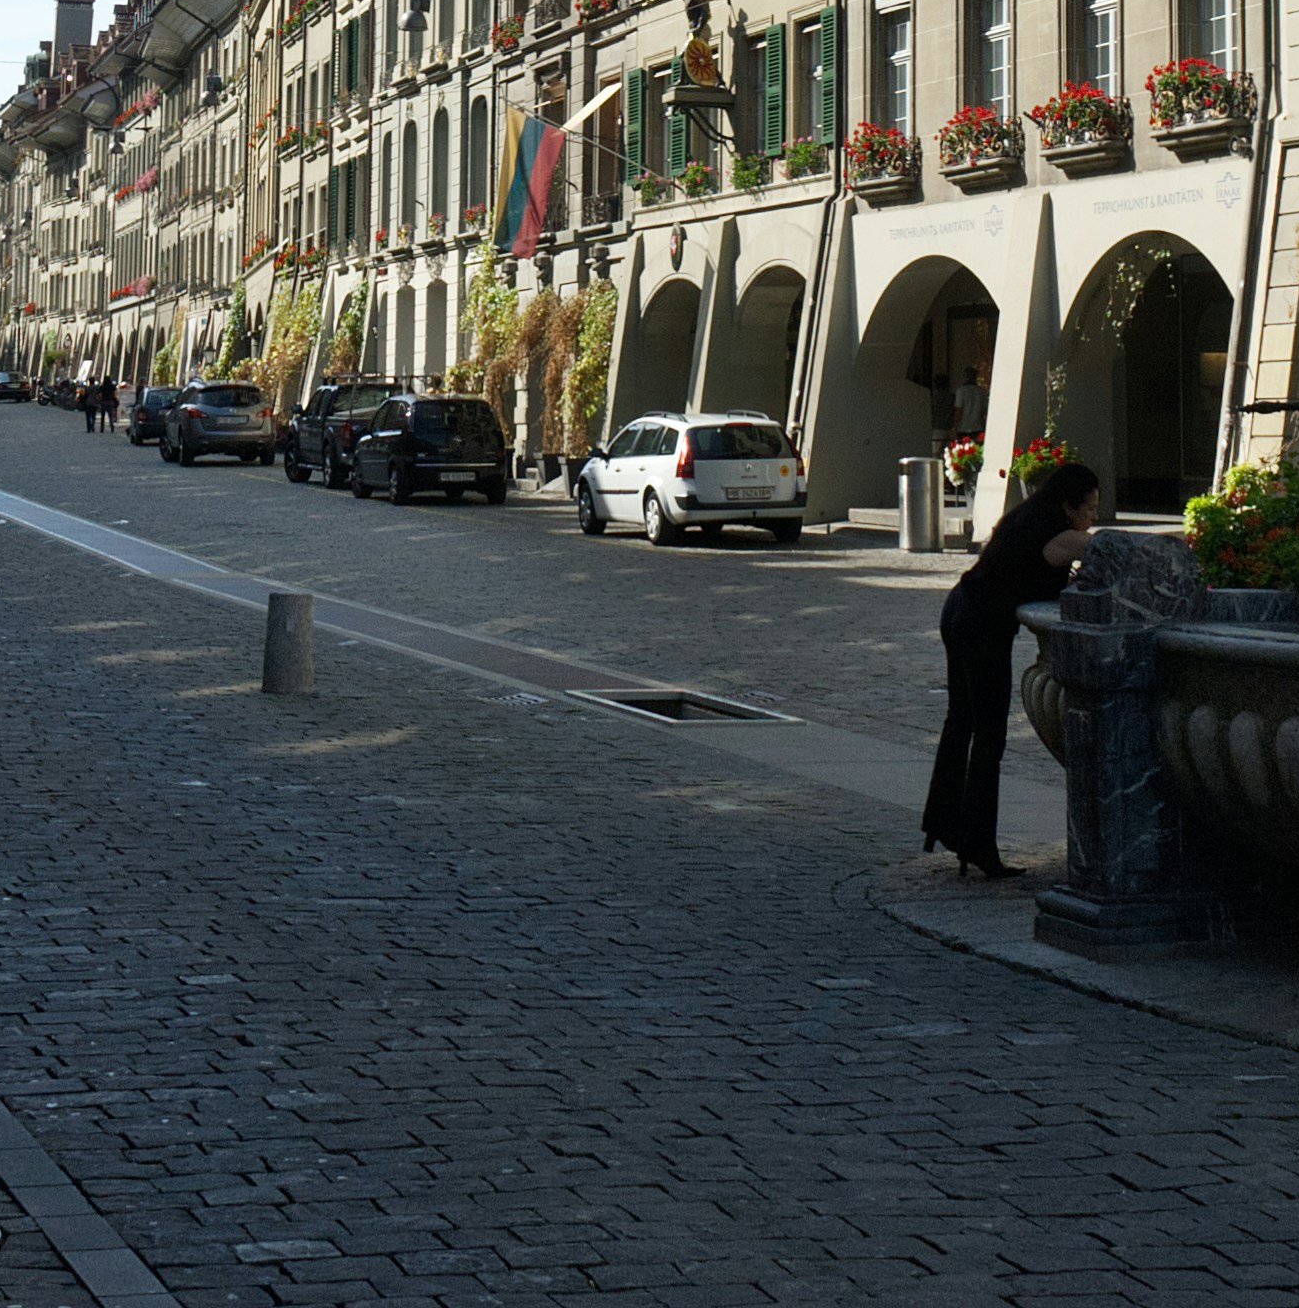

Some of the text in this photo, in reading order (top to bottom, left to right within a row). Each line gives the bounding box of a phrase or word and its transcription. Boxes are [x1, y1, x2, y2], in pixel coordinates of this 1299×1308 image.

[1093, 196, 1149, 214] TEPPICHKUNST
[1157, 187, 1204, 207] RARITÄTEN
[889, 224, 933, 240] TEPPICHKUNST
[939, 219, 976, 235] RARITÄTEN
